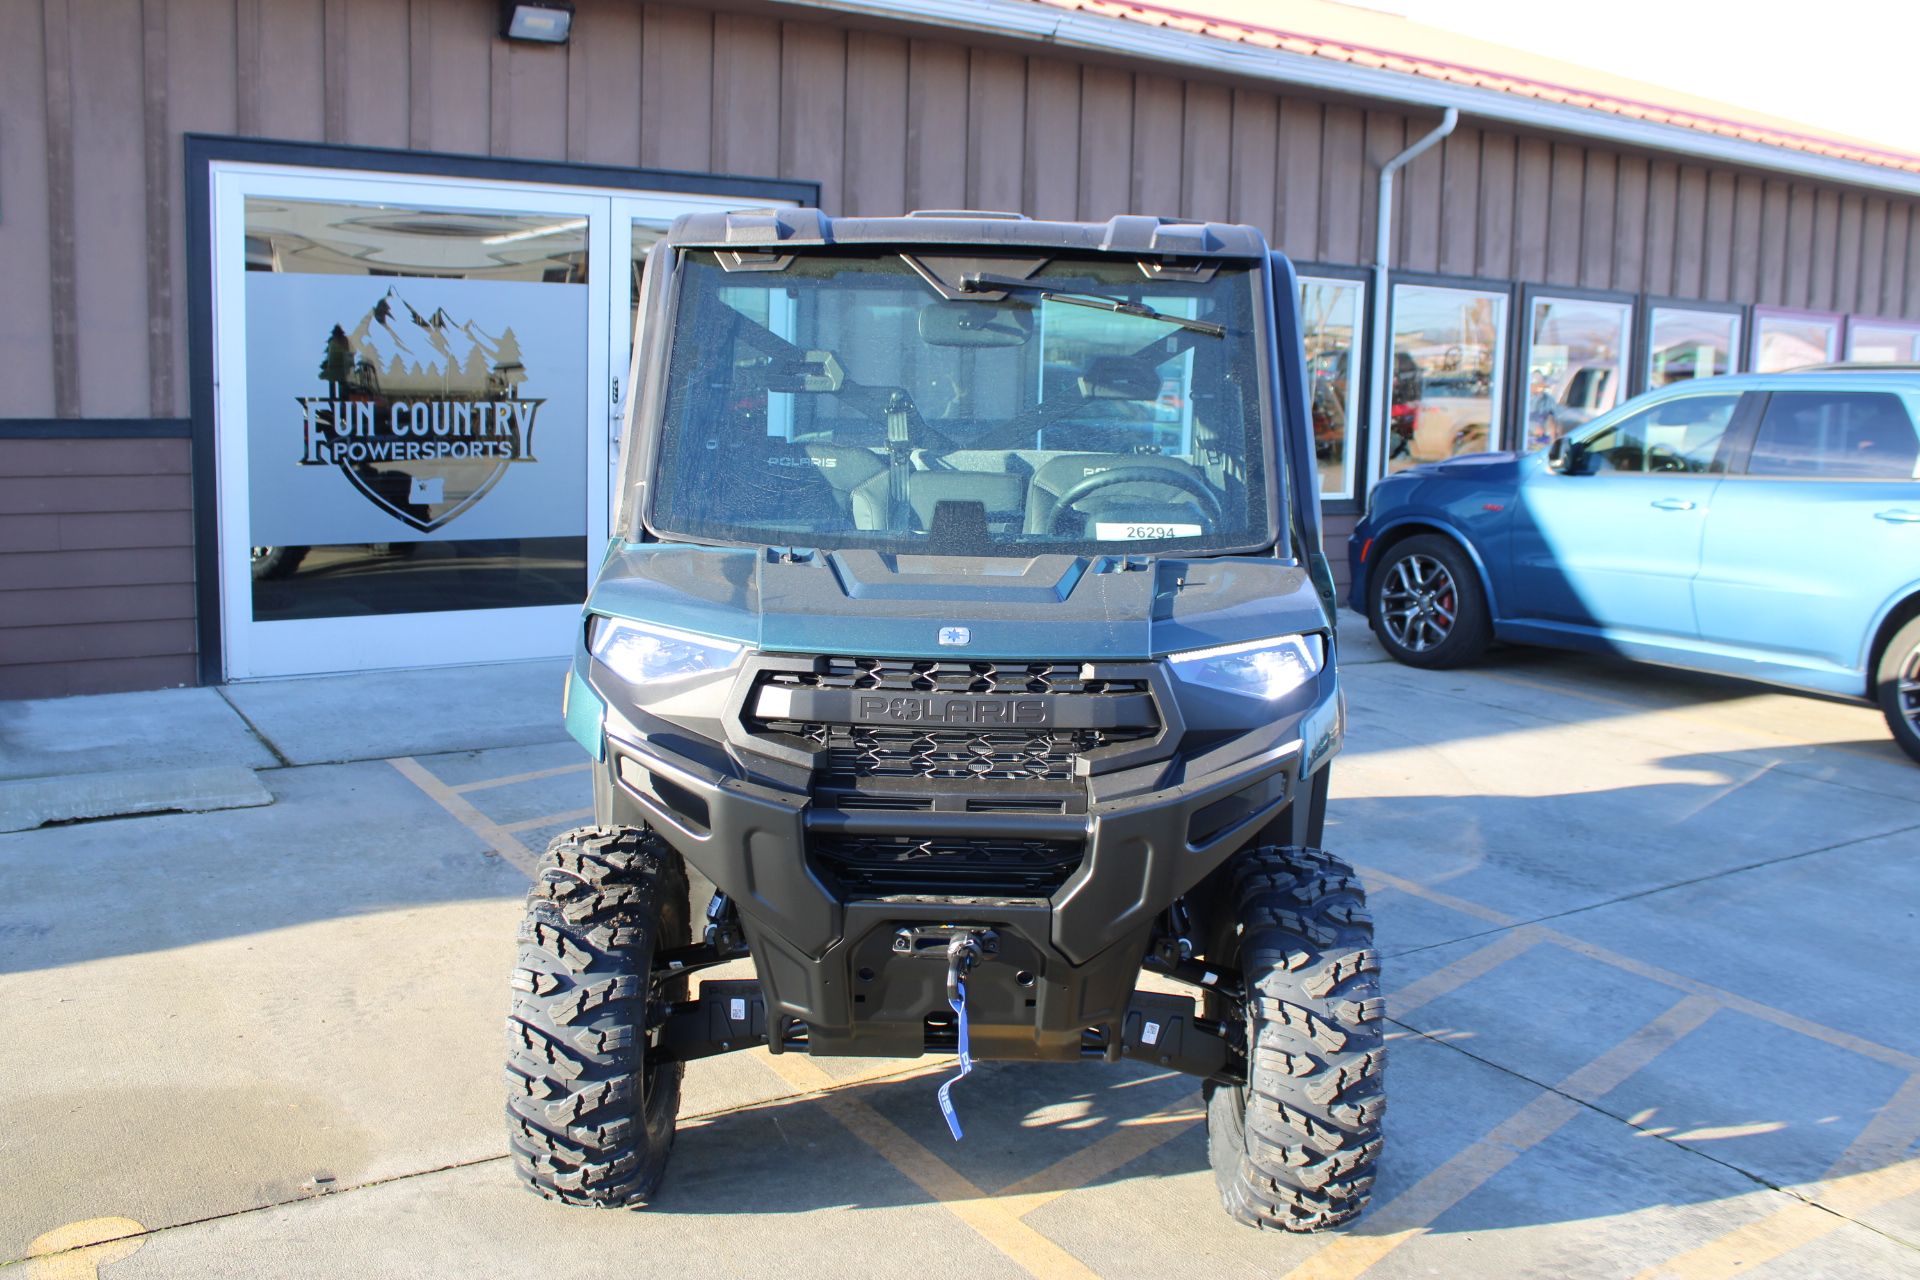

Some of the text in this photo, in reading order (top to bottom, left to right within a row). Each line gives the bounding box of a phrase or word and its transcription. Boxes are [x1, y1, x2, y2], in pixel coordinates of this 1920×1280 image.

[305, 401, 537, 462] FUN COUNTRY
[333, 441, 512, 461] POWERSPORTS
[1126, 526, 1175, 539] 26294
[860, 696, 1046, 723] POLARIS
